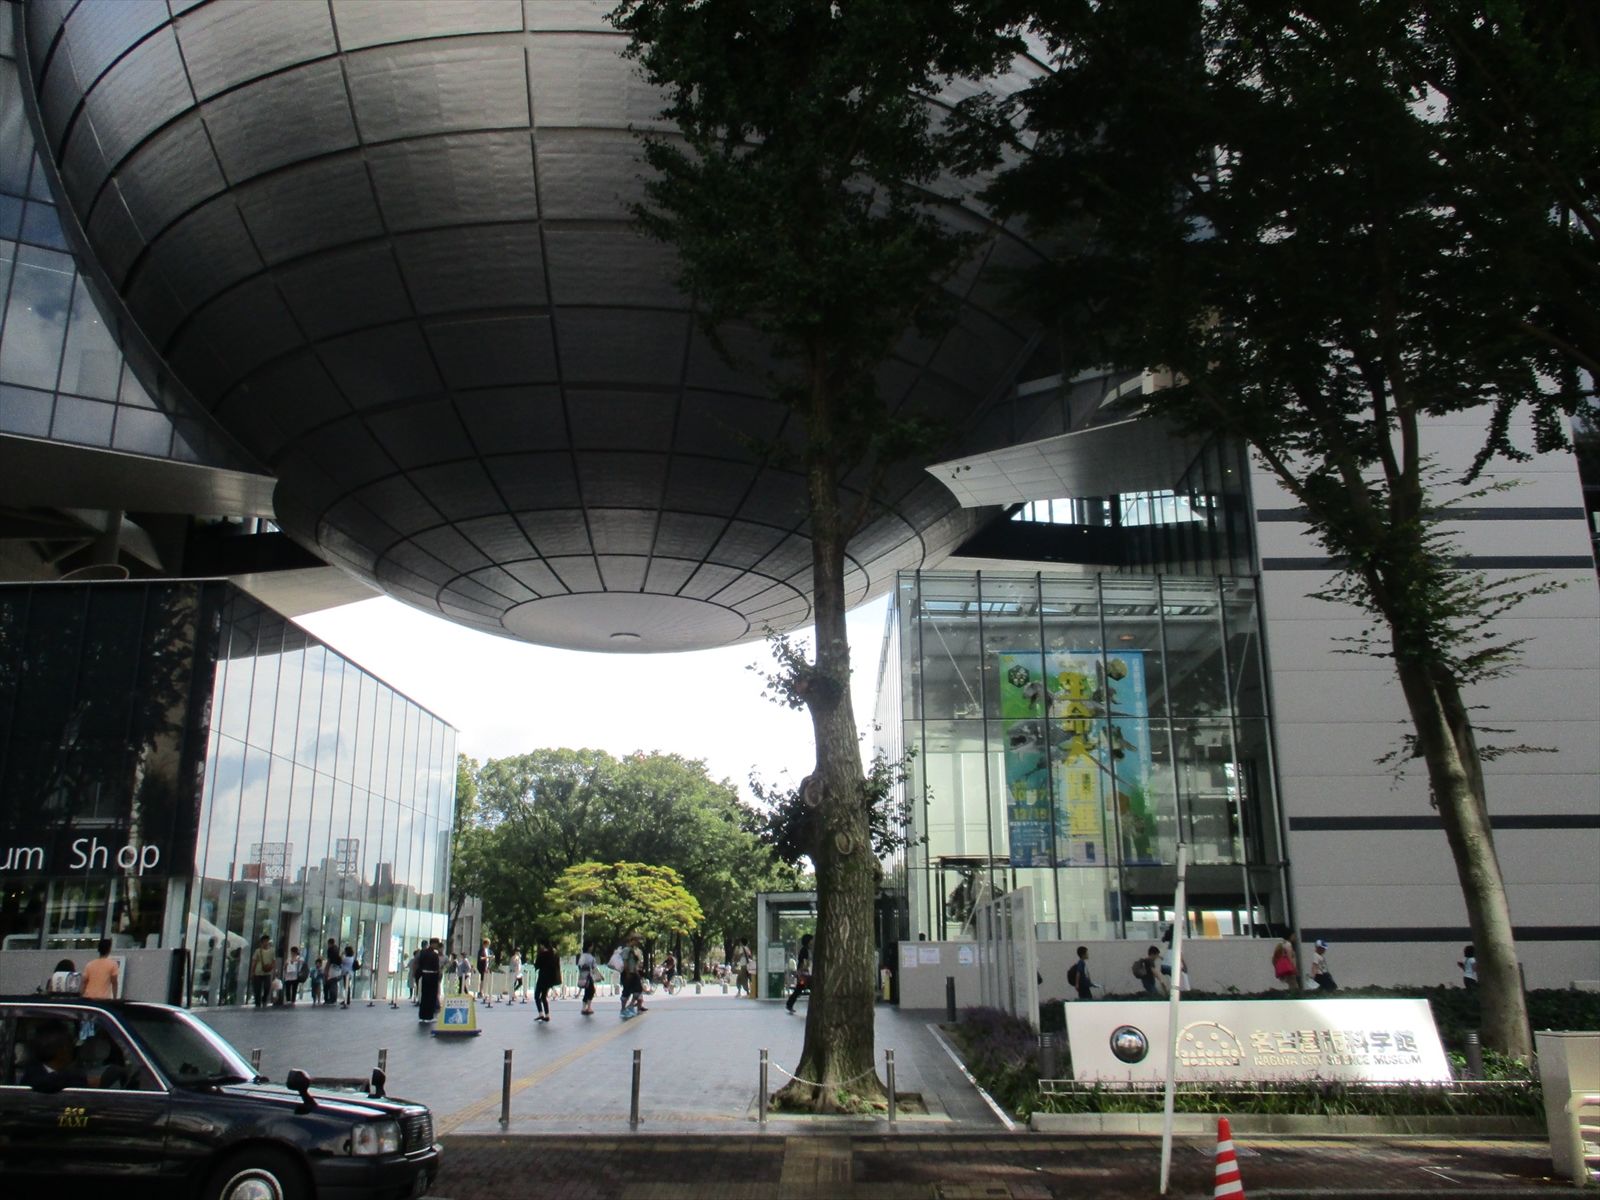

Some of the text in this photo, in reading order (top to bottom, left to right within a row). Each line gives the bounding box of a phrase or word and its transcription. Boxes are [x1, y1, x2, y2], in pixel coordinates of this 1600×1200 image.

[1249, 1028, 1418, 1055] 名古屋市科学館
[1253, 1054, 1422, 1066] NAGOYA CITY SCIENCE MUSEUM
[57, 1115, 89, 1128] TAXI
